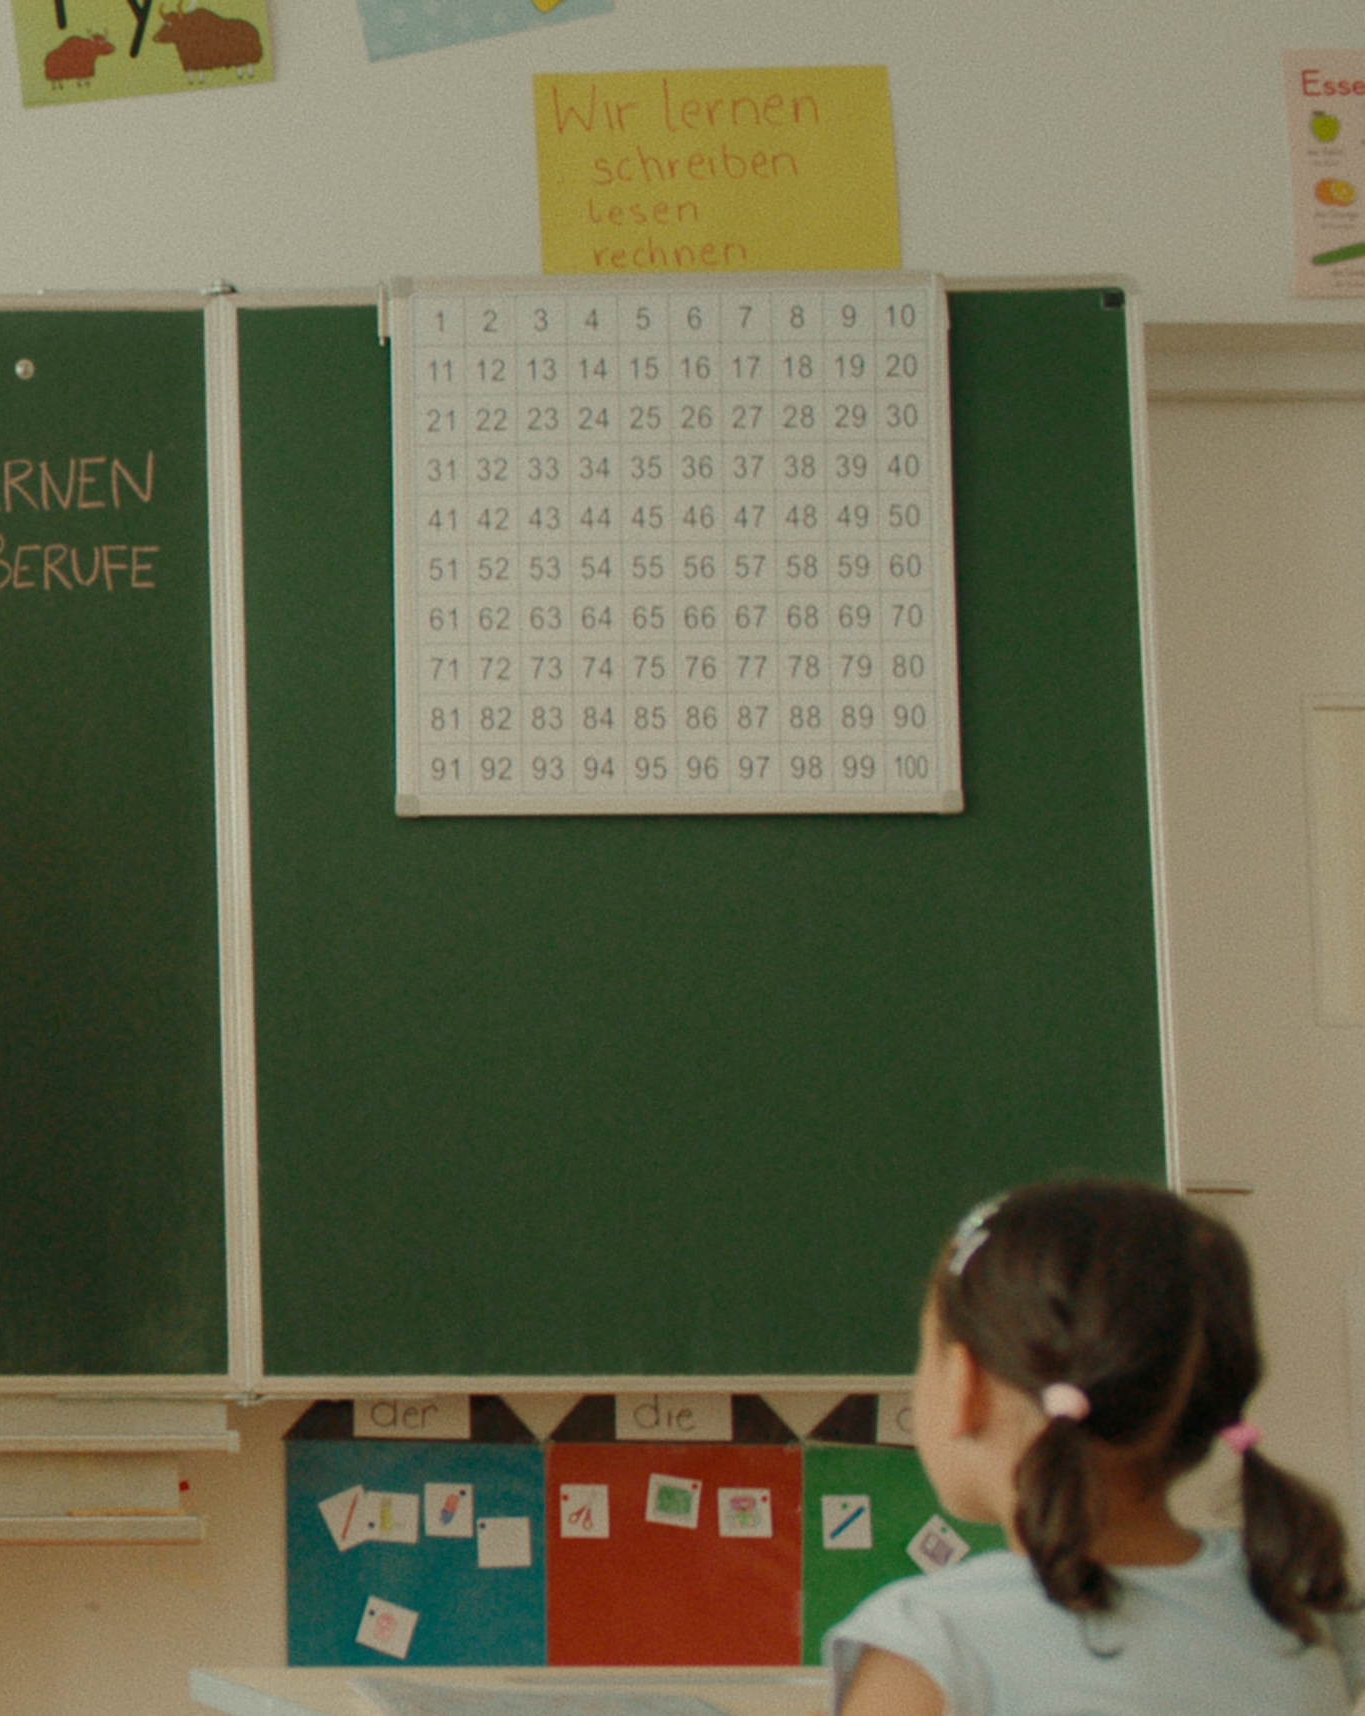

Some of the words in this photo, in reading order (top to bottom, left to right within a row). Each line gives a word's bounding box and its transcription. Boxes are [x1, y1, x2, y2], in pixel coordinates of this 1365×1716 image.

[551, 84, 638, 134] Wir
[593, 143, 799, 186] schreiben
[587, 199, 699, 227] lesen
[592, 236, 748, 268] rechnen
[435, 310, 445, 333] 1
[482, 308, 499, 334] 2
[533, 307, 550, 333] 3
[584, 308, 600, 331] 4
[635, 306, 652, 331] 5
[685, 305, 704, 331] 6
[738, 304, 754, 329] 7
[788, 304, 806, 330] 8
[840, 303, 858, 329] 9
[886, 303, 917, 329] 10
[429, 359, 453, 383] 11
[477, 357, 506, 383] 12
[527, 356, 558, 382] 13
[579, 357, 608, 380] 14
[630, 355, 660, 381] 15
[681, 354, 712, 380] 16
[732, 354, 762, 379] 17
[783, 353, 814, 379] 18
[835, 353, 866, 379] 19
[885, 352, 919, 379] 20
[426, 408, 456, 434] 21
[475, 407, 508, 433] 22
[526, 406, 560, 432] 23
[578, 406, 610, 431] 24
[629, 405, 662, 431] 25
[680, 404, 713, 430] 26
[731, 404, 764, 430] 27
[782, 403, 816, 430] 28
[834, 403, 868, 429] 29
[886, 402, 919, 429] 30
[427, 458, 457, 483] 31
[476, 456, 509, 482] 32
[527, 455, 561, 481] 33
[579, 455, 611, 480] 34
[630, 454, 663, 481] 35
[682, 454, 714, 480] 36
[733, 454, 765, 480] 37
[784, 453, 817, 480] 38
[836, 453, 868, 479] 39
[887, 453, 921, 478] 40
[427, 508, 457, 531] 41
[476, 506, 510, 532] 42
[528, 505, 561, 531] 43
[579, 506, 612, 529] 44
[631, 504, 664, 530] 45
[682, 504, 715, 530] 46
[733, 504, 766, 528] 47
[784, 503, 818, 529] 48
[836, 504, 870, 529] 49
[888, 502, 922, 529] 50
[428, 557, 458, 582] 51
[478, 556, 510, 582] 52
[529, 555, 562, 582] 53
[580, 555, 612, 580] 54
[632, 554, 665, 580] 55
[683, 554, 716, 580] 56
[734, 553, 767, 580] 57
[786, 553, 819, 579] 58
[837, 553, 871, 580] 59
[888, 553, 923, 579] 60
[428, 607, 458, 632] 61
[477, 606, 511, 632] 62
[529, 605, 563, 631] 63
[580, 605, 613, 630] 64
[631, 604, 666, 630] 65
[683, 604, 717, 630] 66
[734, 603, 768, 630] 67
[786, 603, 820, 630] 68
[837, 603, 872, 629] 69
[892, 602, 924, 629] 70
[430, 656, 459, 681] 71
[480, 656, 512, 682] 72
[531, 655, 564, 681] 73
[583, 655, 614, 679] 74
[634, 654, 666, 680] 75
[685, 654, 718, 680] 76
[736, 654, 768, 679] 77
[788, 653, 821, 680] 78
[841, 653, 873, 679] 79
[891, 653, 926, 679] 80
[430, 706, 460, 732] 81
[479, 705, 513, 732] 82
[530, 705, 564, 731] 83
[582, 705, 615, 730] 84
[633, 705, 667, 731] 85
[685, 704, 719, 730] 86
[736, 704, 770, 730] 87
[788, 704, 822, 730] 88
[841, 703, 875, 730] 89
[892, 703, 927, 729] 90
[430, 756, 461, 781] 91
[479, 756, 513, 782] 92
[531, 755, 565, 781] 93
[583, 756, 615, 781] 94
[634, 755, 668, 781] 95
[685, 755, 720, 780] 96
[738, 755, 771, 780] 97
[789, 754, 824, 780] 98
[842, 754, 876, 779] 99
[894, 754, 929, 779] 100
